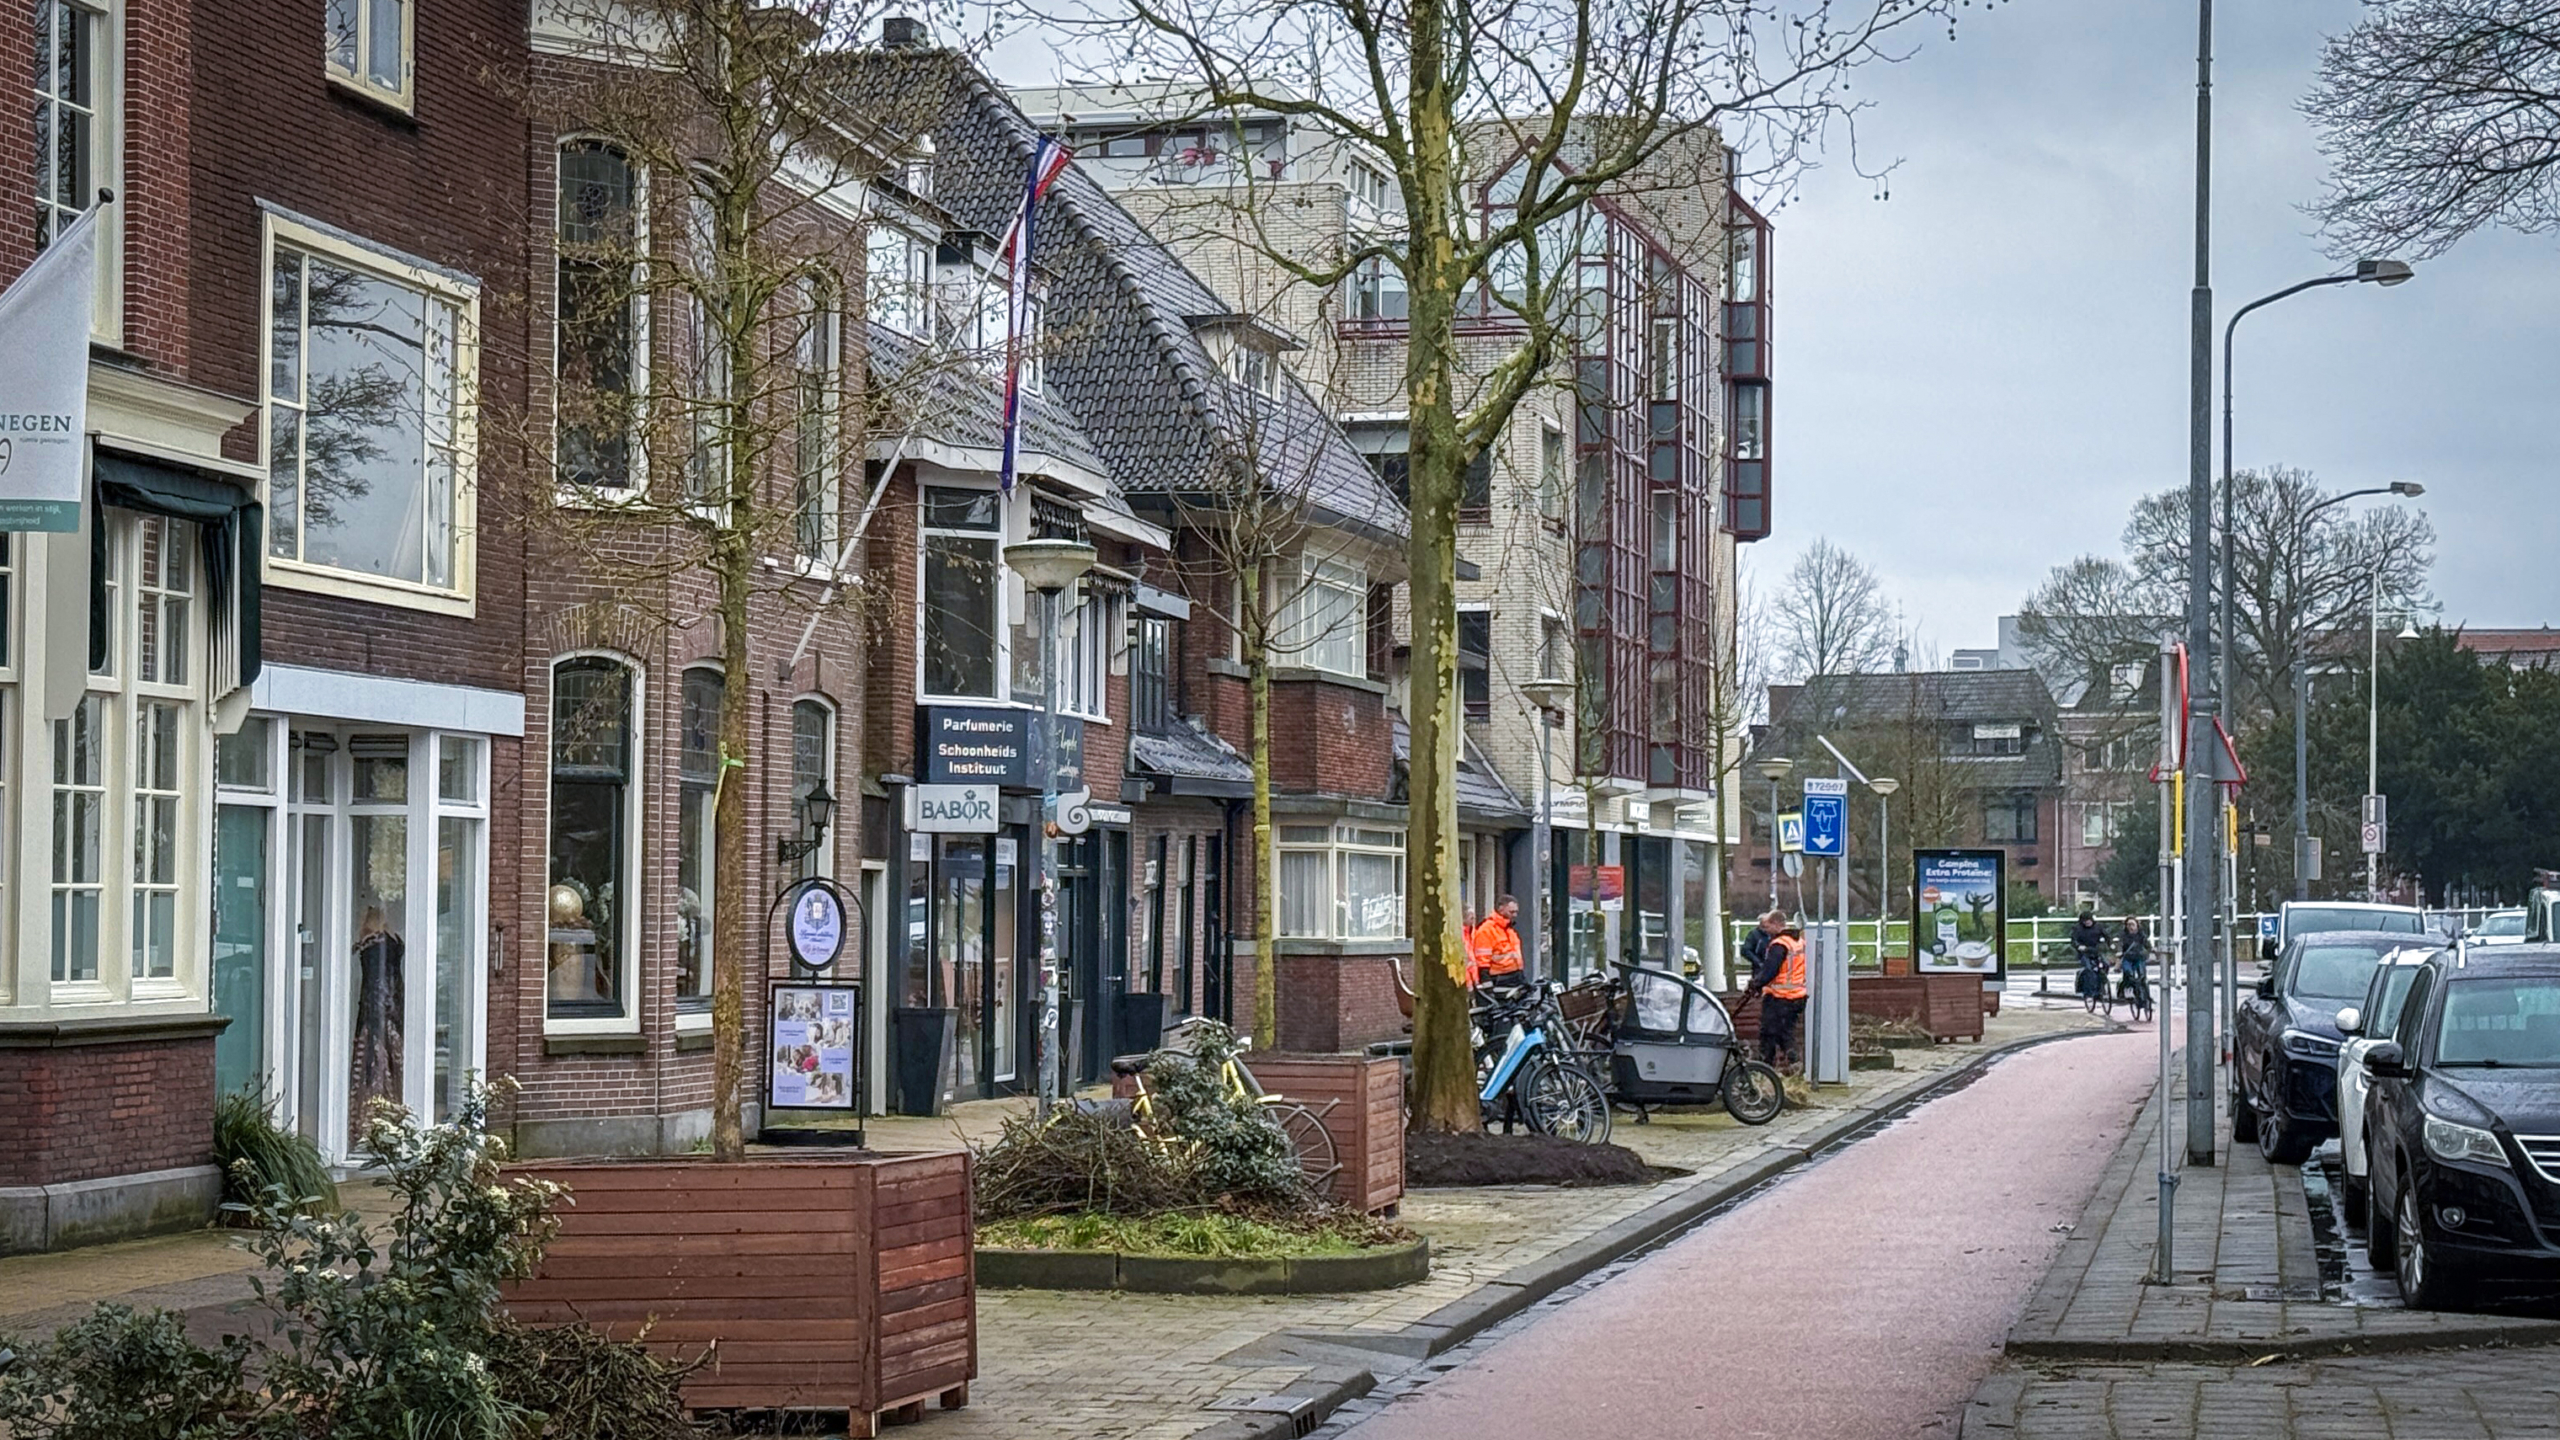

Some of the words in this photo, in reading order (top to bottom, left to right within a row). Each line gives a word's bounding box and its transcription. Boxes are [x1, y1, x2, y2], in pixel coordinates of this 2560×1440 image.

[943, 718, 1014, 733] Parfumerie
[938, 743, 1018, 758] Schoonheids
[949, 761, 1007, 775] Instituut
[921, 800, 993, 823] BABOR
[1938, 860, 1979, 868] Campina
[1925, 868, 1951, 877] Extra
